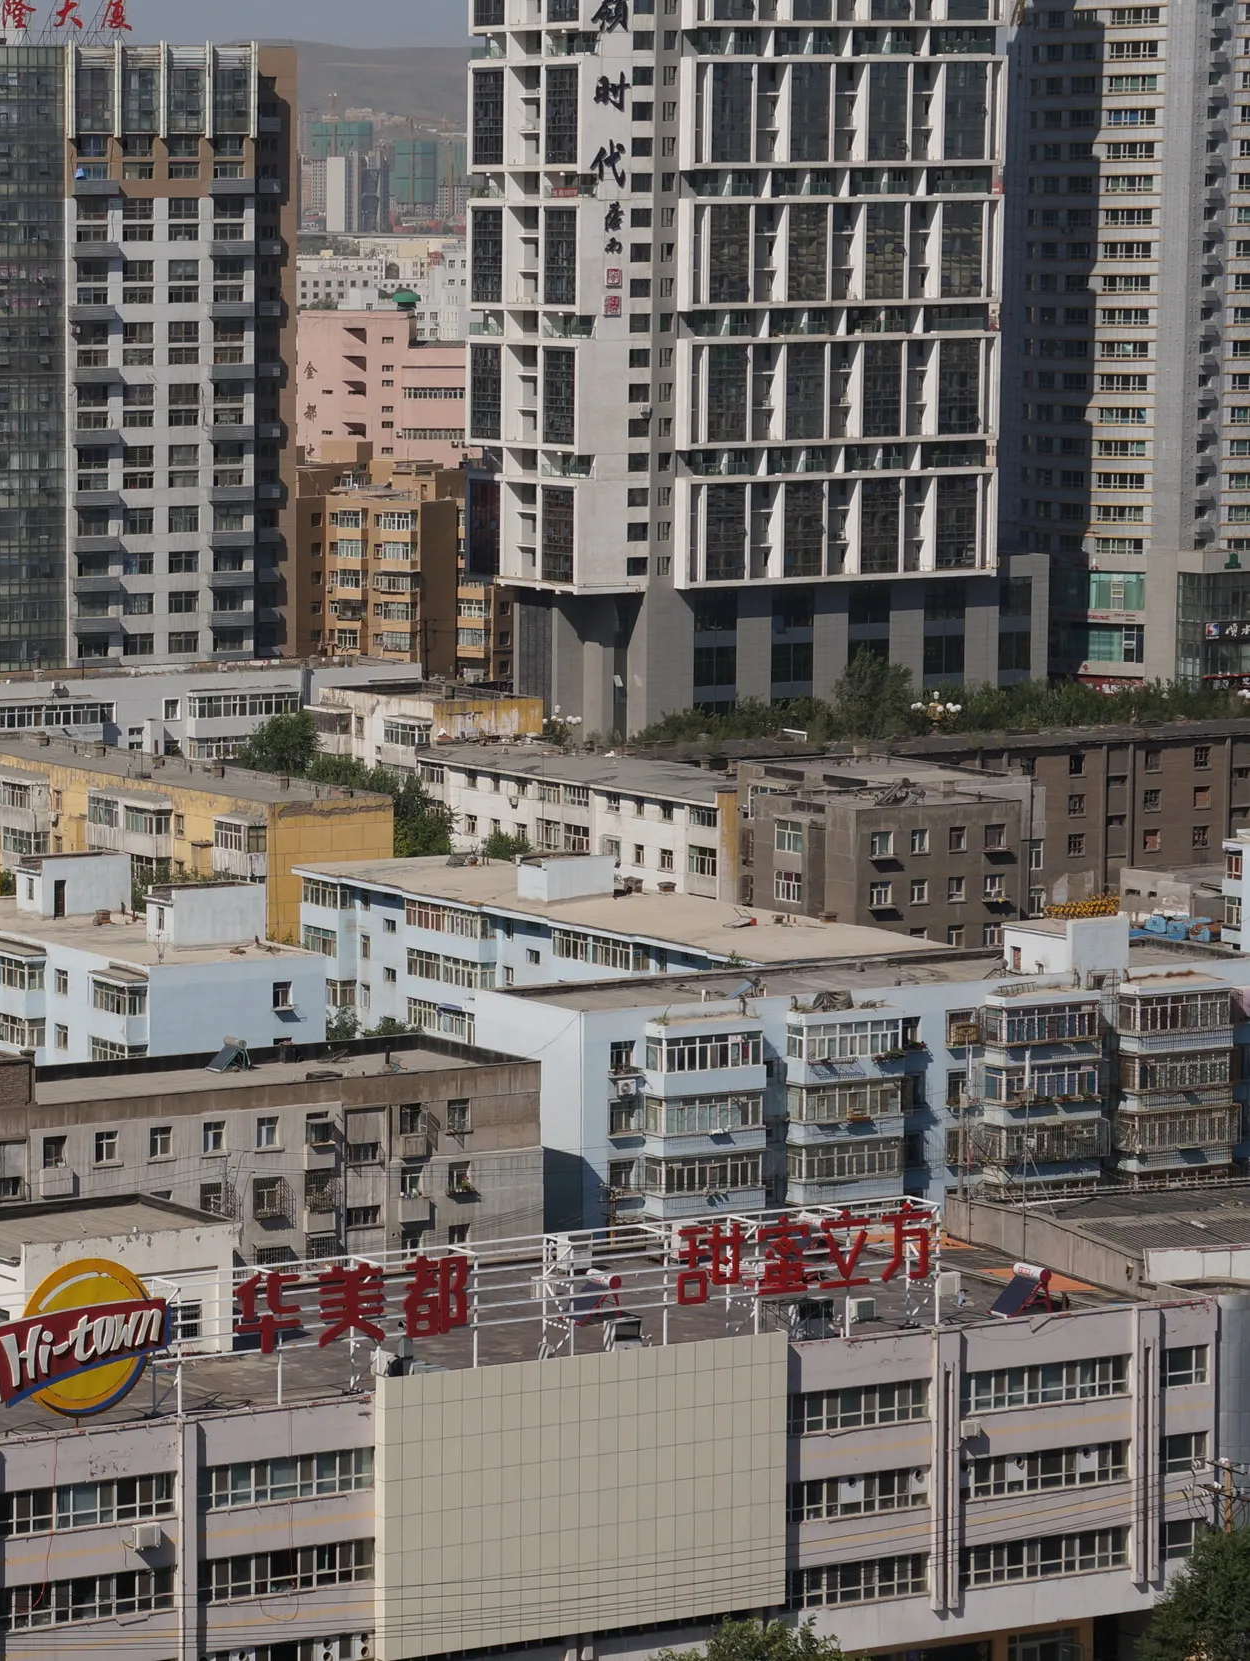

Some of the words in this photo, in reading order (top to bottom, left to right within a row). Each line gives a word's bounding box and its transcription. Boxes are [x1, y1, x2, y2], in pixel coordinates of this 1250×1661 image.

[234, 1255, 468, 1354] 华美都
[677, 1202, 933, 1305] 甜蜜立方
[0, 1308, 162, 1387] Hi-town
